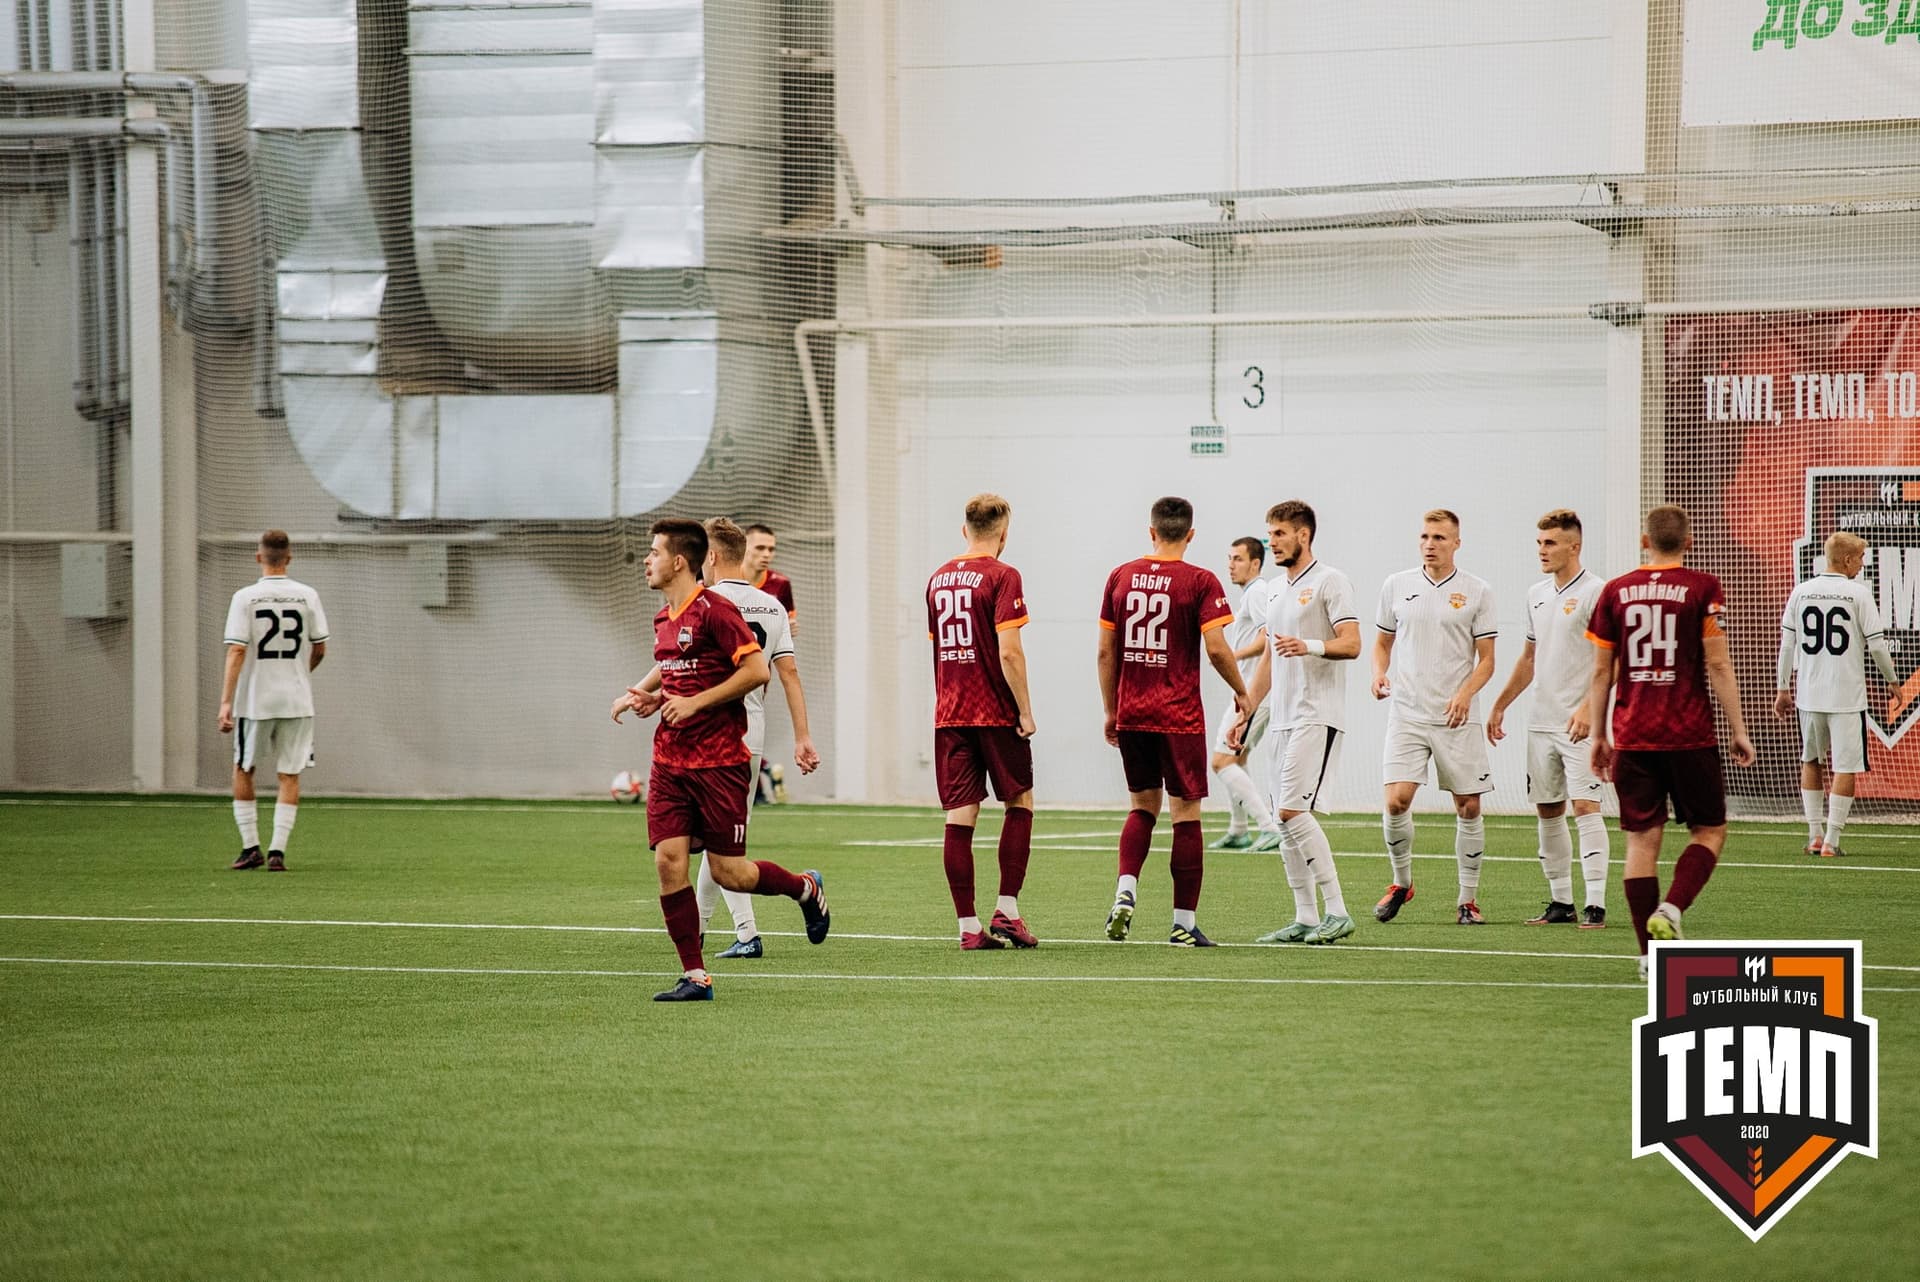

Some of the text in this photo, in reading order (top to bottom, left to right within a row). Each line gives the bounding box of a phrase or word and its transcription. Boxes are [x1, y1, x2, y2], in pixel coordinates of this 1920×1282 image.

[1243, 366, 1264, 409] 3
[1703, 371, 1920, 425] ТЕМП, ТЕМП, ТО
[1131, 573, 1172, 592] БАБИЧ
[255, 609, 303, 659] 23
[935, 588, 972, 648] 25
[1124, 591, 1171, 650] 22
[1625, 604, 1678, 667] 24
[1802, 606, 1851, 656] 96
